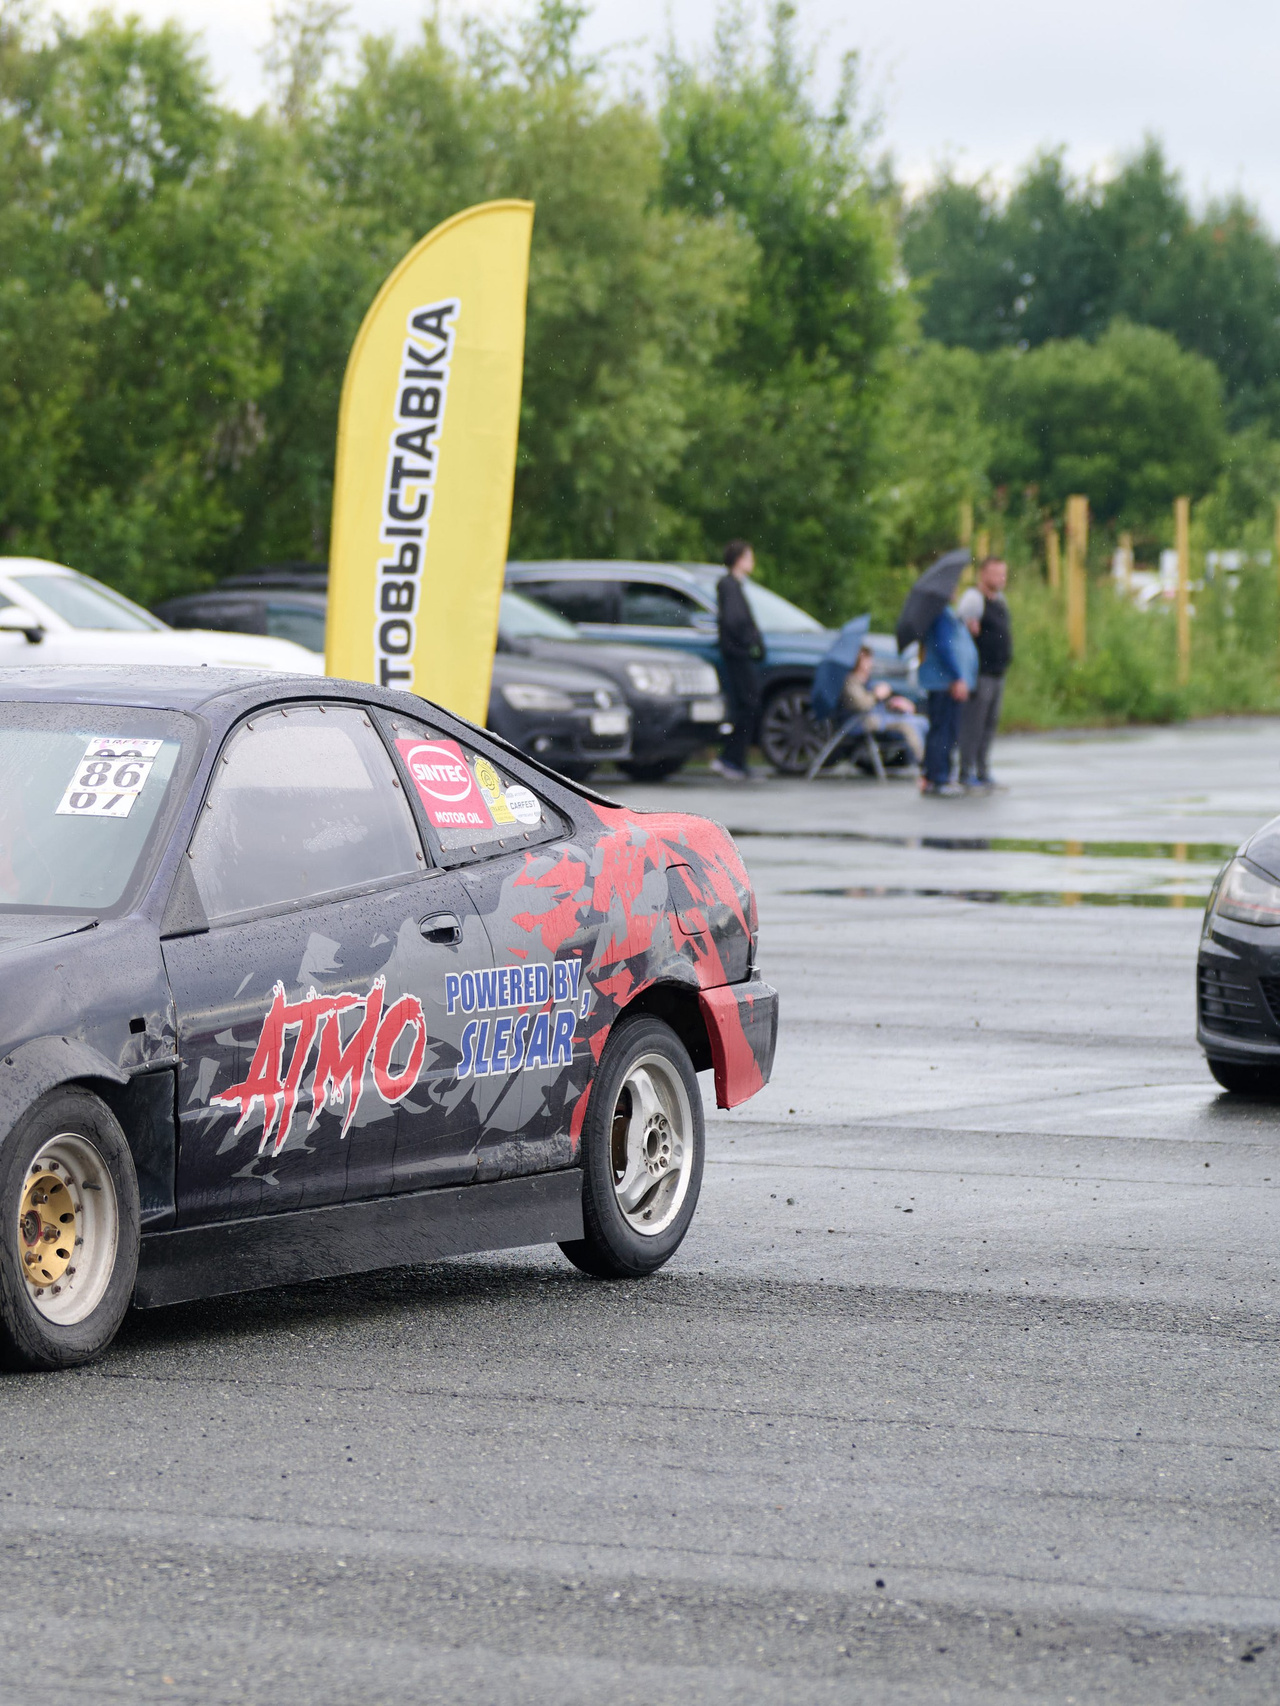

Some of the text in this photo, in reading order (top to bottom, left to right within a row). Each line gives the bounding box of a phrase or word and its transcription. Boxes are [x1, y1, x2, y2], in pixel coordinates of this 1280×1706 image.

[79, 761, 145, 788] 86
[412, 763, 468, 783] SINTEC
[435, 811, 467, 823] MOTOR
[468, 813, 484, 824] OIL
[509, 800, 537, 810] CARFEST
[445, 963, 550, 1014] POWERED
[457, 1010, 576, 1079] SLESAR
[210, 974, 427, 1158] ATMO
